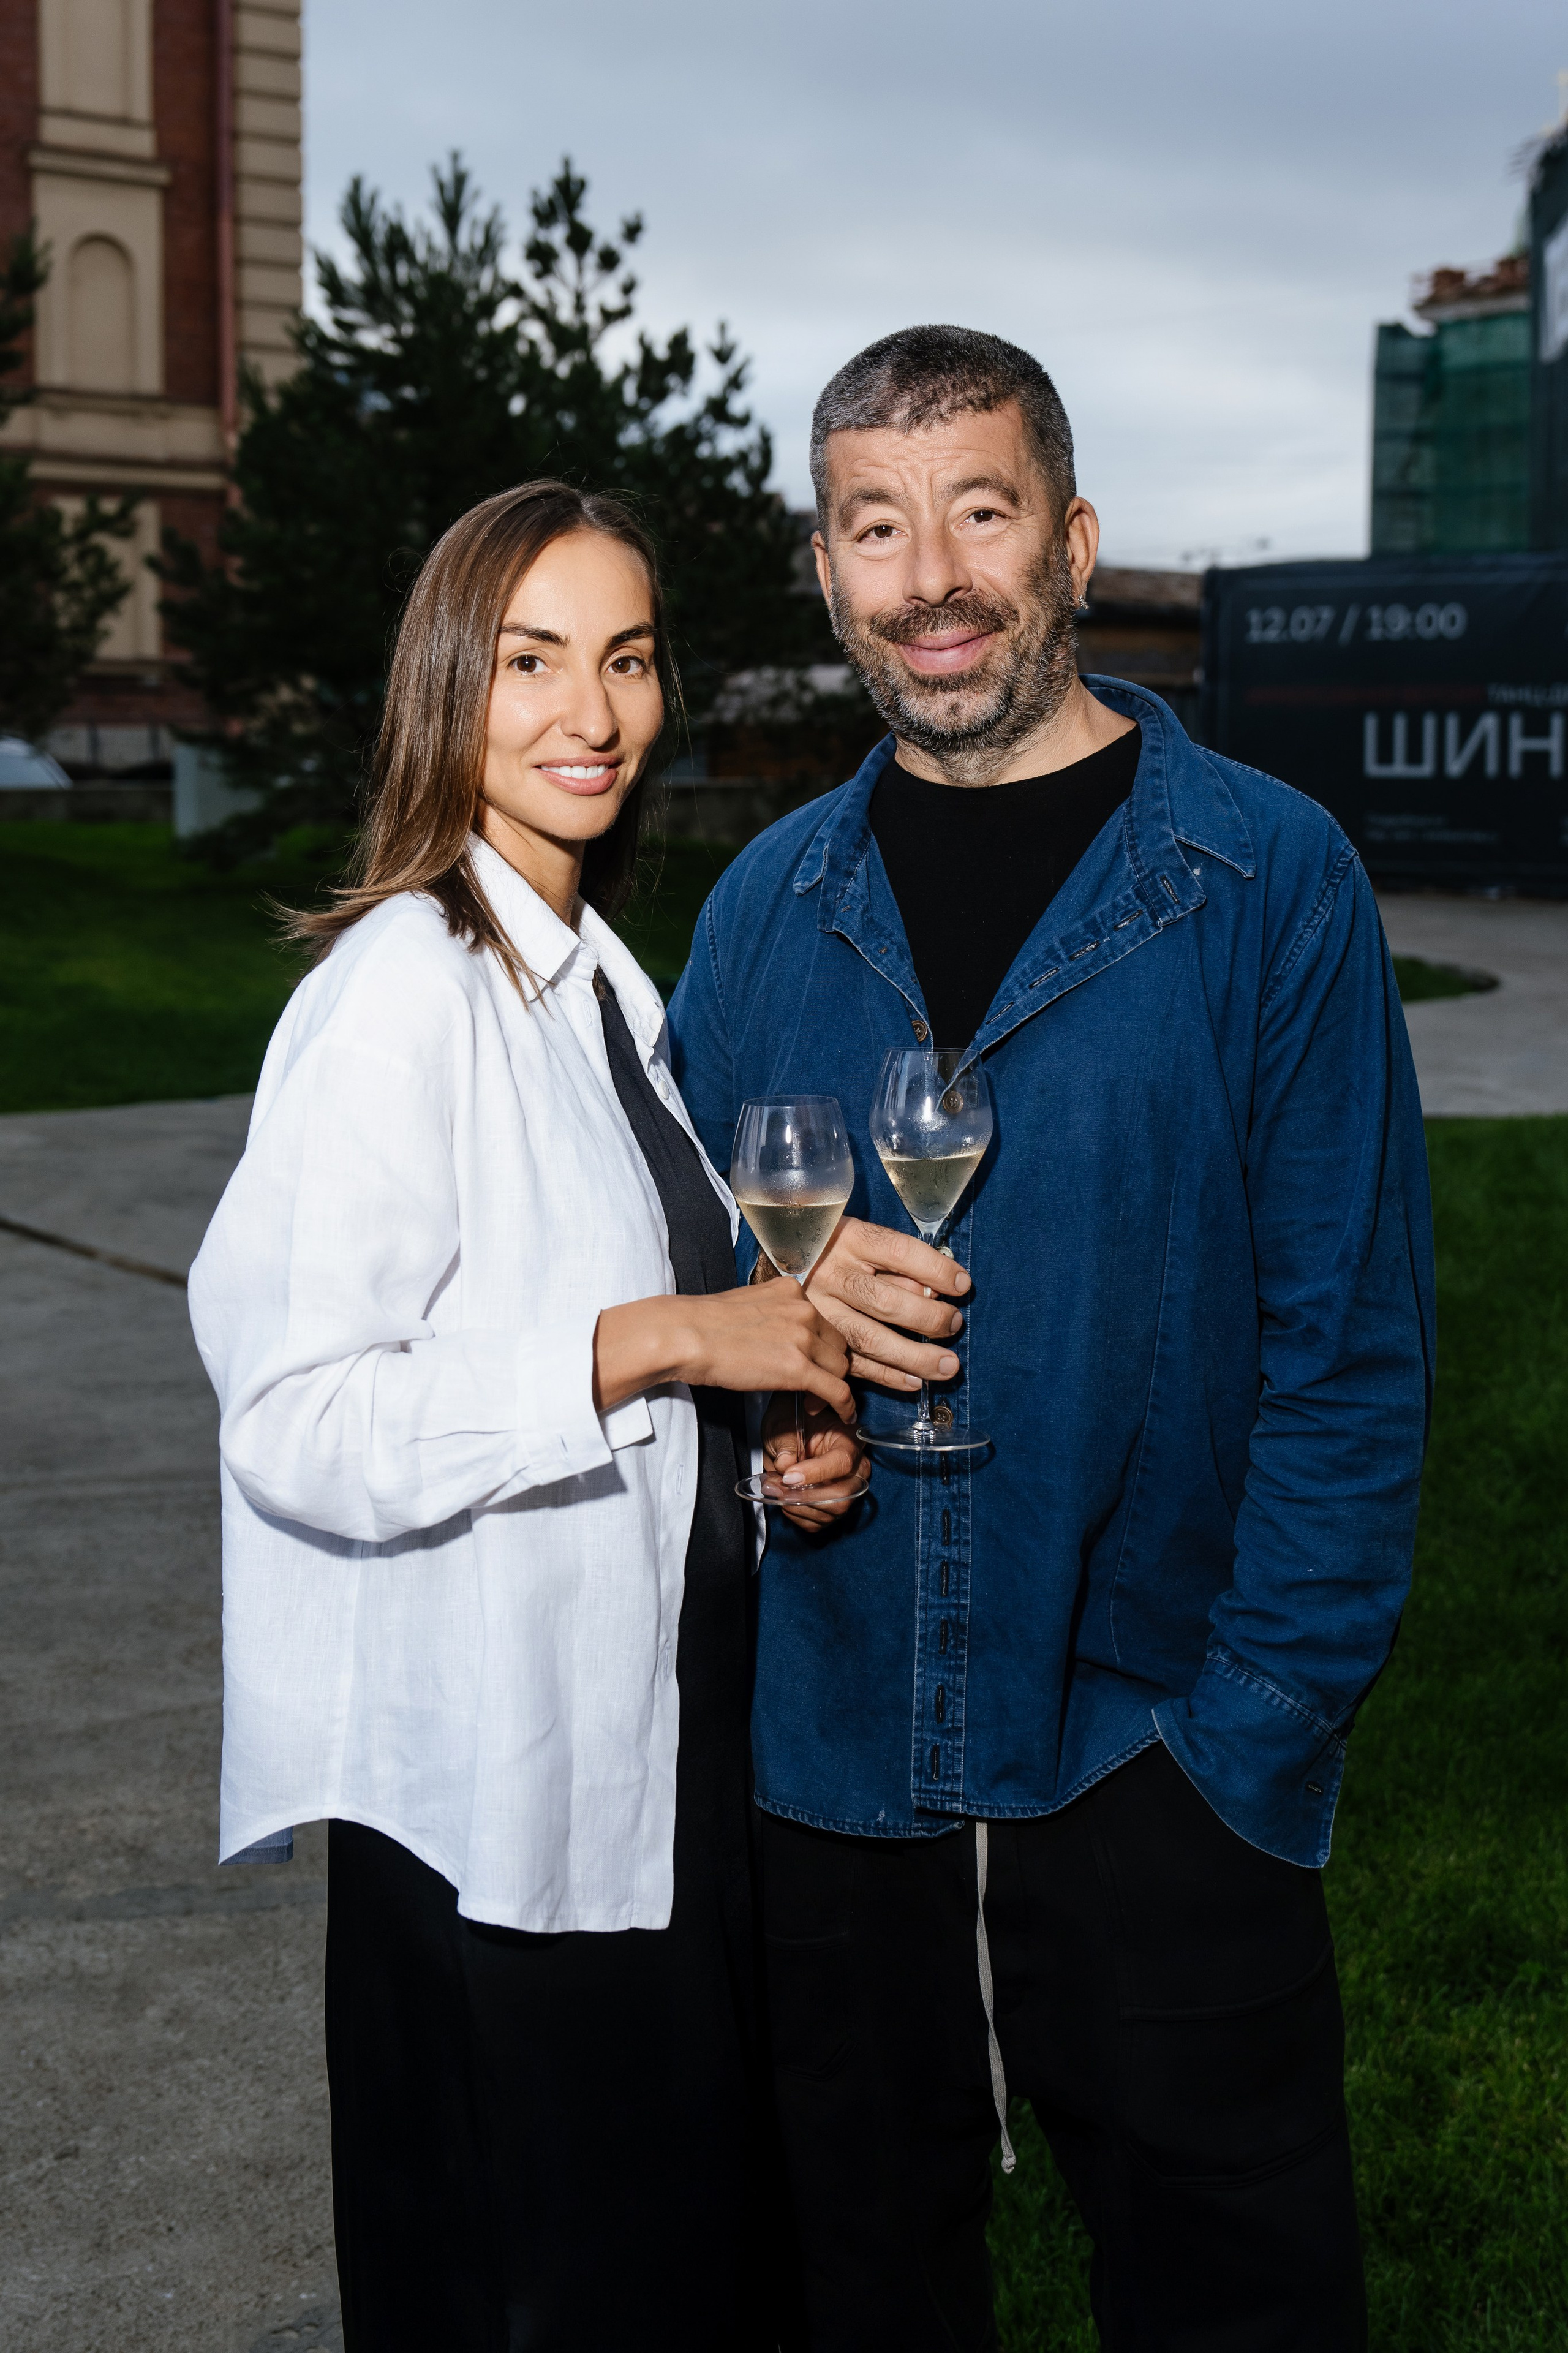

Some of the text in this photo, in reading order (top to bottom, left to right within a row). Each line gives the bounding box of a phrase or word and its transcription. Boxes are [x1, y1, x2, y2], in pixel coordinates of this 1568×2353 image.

[1246, 605, 1336, 644] 12.07
[1366, 602, 1468, 642] 19:00
[1363, 711, 1564, 779] ШИН
